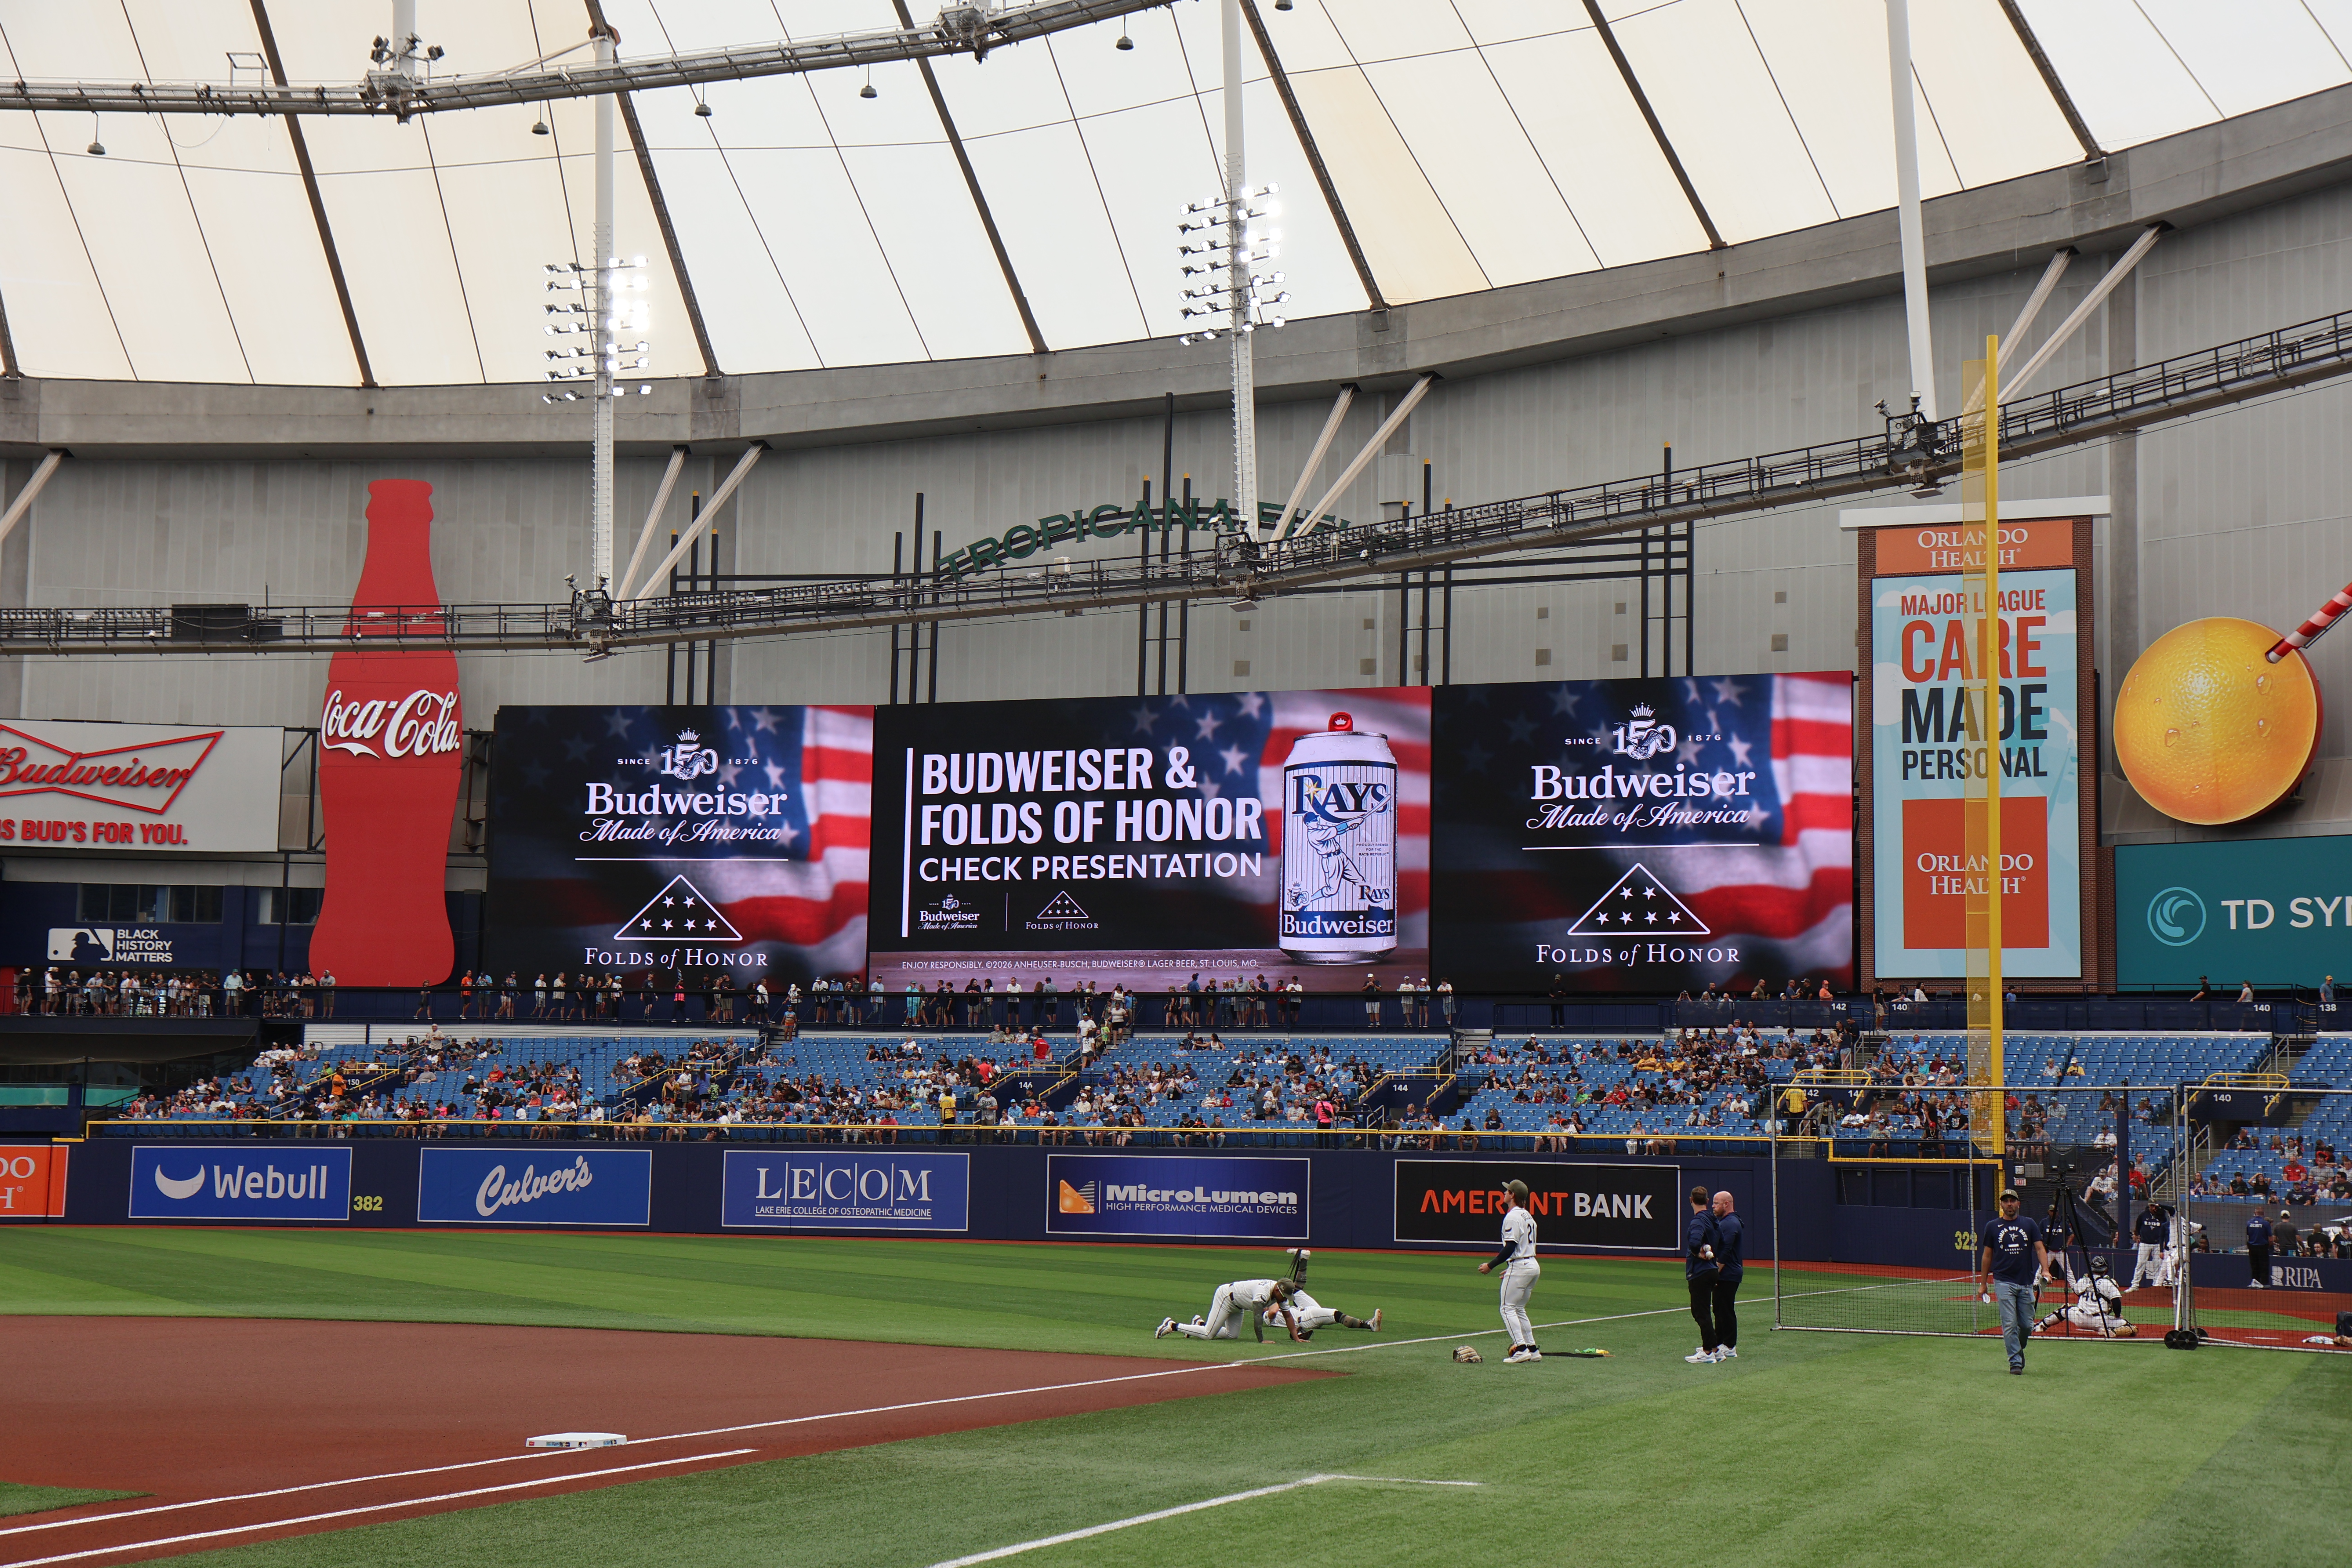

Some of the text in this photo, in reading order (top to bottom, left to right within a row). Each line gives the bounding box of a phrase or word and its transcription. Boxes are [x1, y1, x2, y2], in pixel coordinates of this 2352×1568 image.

[935, 497, 1239, 582] TROPICANA
[1901, 589, 2045, 616] MAJOR LAGUE
[1902, 616, 2047, 683] CARE
[1902, 684, 2047, 743] MADE
[1565, 737, 1601, 745] SINCE
[922, 745, 1197, 795] BUDWEISER &
[1531, 763, 1755, 800] Budweiser
[584, 783, 787, 816] Budweiser
[920, 796, 1262, 846] FOLDS OF HONOR
[1526, 801, 1750, 832] Made of America
[21, 820, 87, 842] BUD'S
[92, 822, 134, 843] FOR
[139, 823, 189, 844] YOU.
[579, 818, 782, 846] Made of America
[918, 851, 1262, 882] CHECK PRESENTATION
[1358, 885, 1390, 903] RAYS
[919, 910, 980, 922] Budweiser
[1283, 914, 1392, 935] Budweiser
[2221, 899, 2275, 930] TD
[116, 929, 159, 939] BLACK
[917, 922, 941, 930] Made
[941, 922, 952, 931] of
[1055, 922, 1064, 931] of
[116, 941, 172, 951] HISTORY
[1536, 944, 1740, 967] FOLDS of HONOR
[116, 953, 173, 962] MATTERS
[584, 947, 768, 969] FOLDS of HONOR
[1014, 960, 1090, 969] ANHEUSER-BUSCH,
[1176, 960, 1198, 968] BEER,
[1212, 960, 1239, 968] LOUIS,
[2213, 1094, 2232, 1102] 140
[213, 1164, 327, 1200] Webull
[353, 1196, 383, 1211] 382
[1106, 1184, 1297, 1204] MicroLumen
[1420, 1189, 1653, 1220] AMERNT BANK
[793, 1207, 827, 1215] COLLEGE
[840, 1208, 892, 1216] OSTEOPATHIC
[894, 1208, 931, 1216] MEDICINE
[1135, 1203, 1206, 1212] PERFORMANCE
[1527, 1223, 1535, 1244] 21
[1955, 1230, 1978, 1251] 322
[1998, 1228, 2009, 1243] TAMPA
[2018, 1229, 2028, 1241] RAYS
[2284, 1267, 2323, 1289] RIPA
